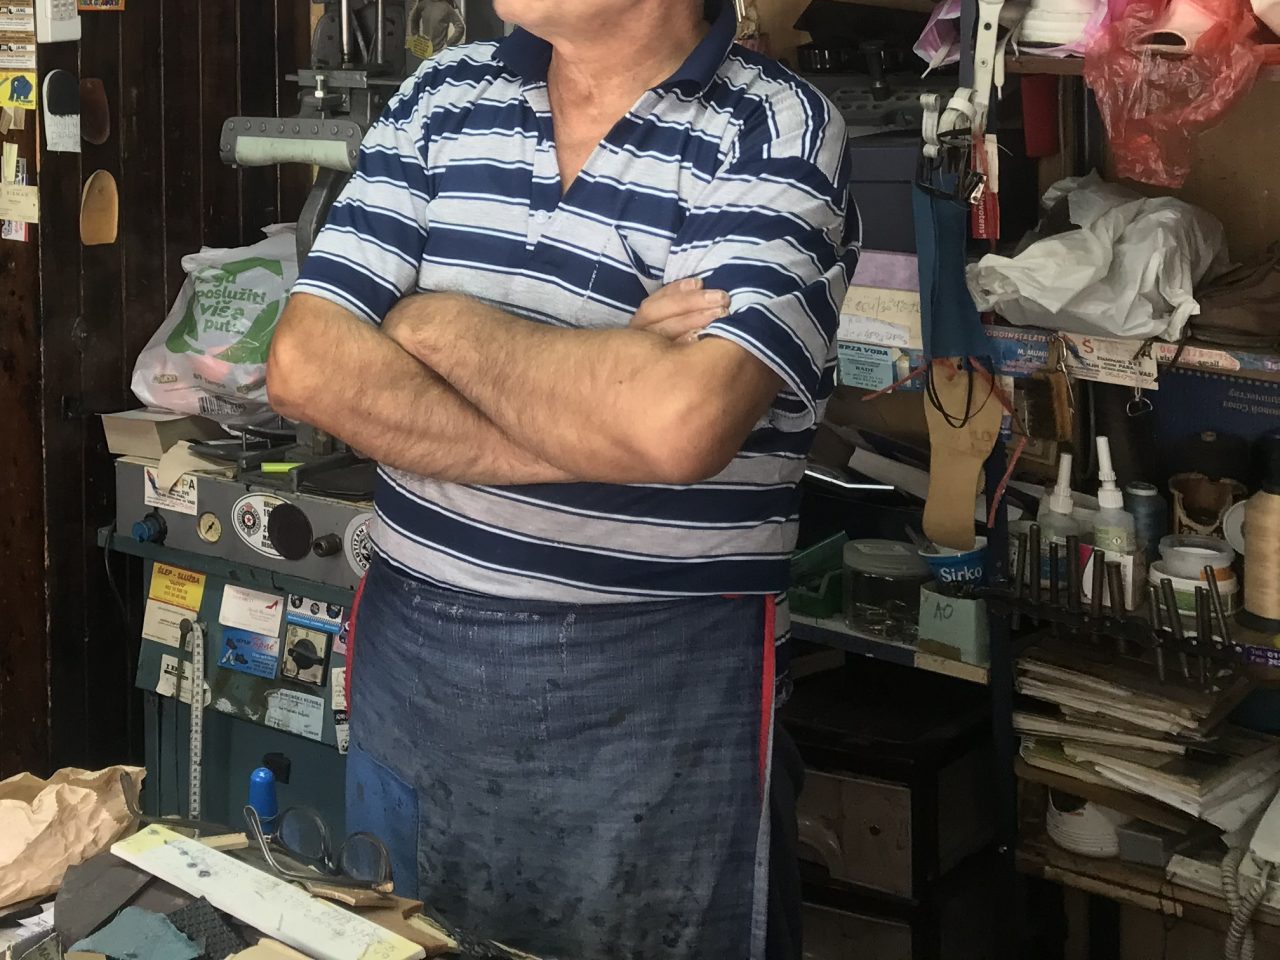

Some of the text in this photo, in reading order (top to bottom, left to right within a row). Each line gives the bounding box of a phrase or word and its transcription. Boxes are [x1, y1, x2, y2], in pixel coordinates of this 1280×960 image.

[864, 347, 888, 356] VODA
[158, 566, 200, 584] ŠLEP SLUŽBA
[940, 564, 982, 585] Sirko
